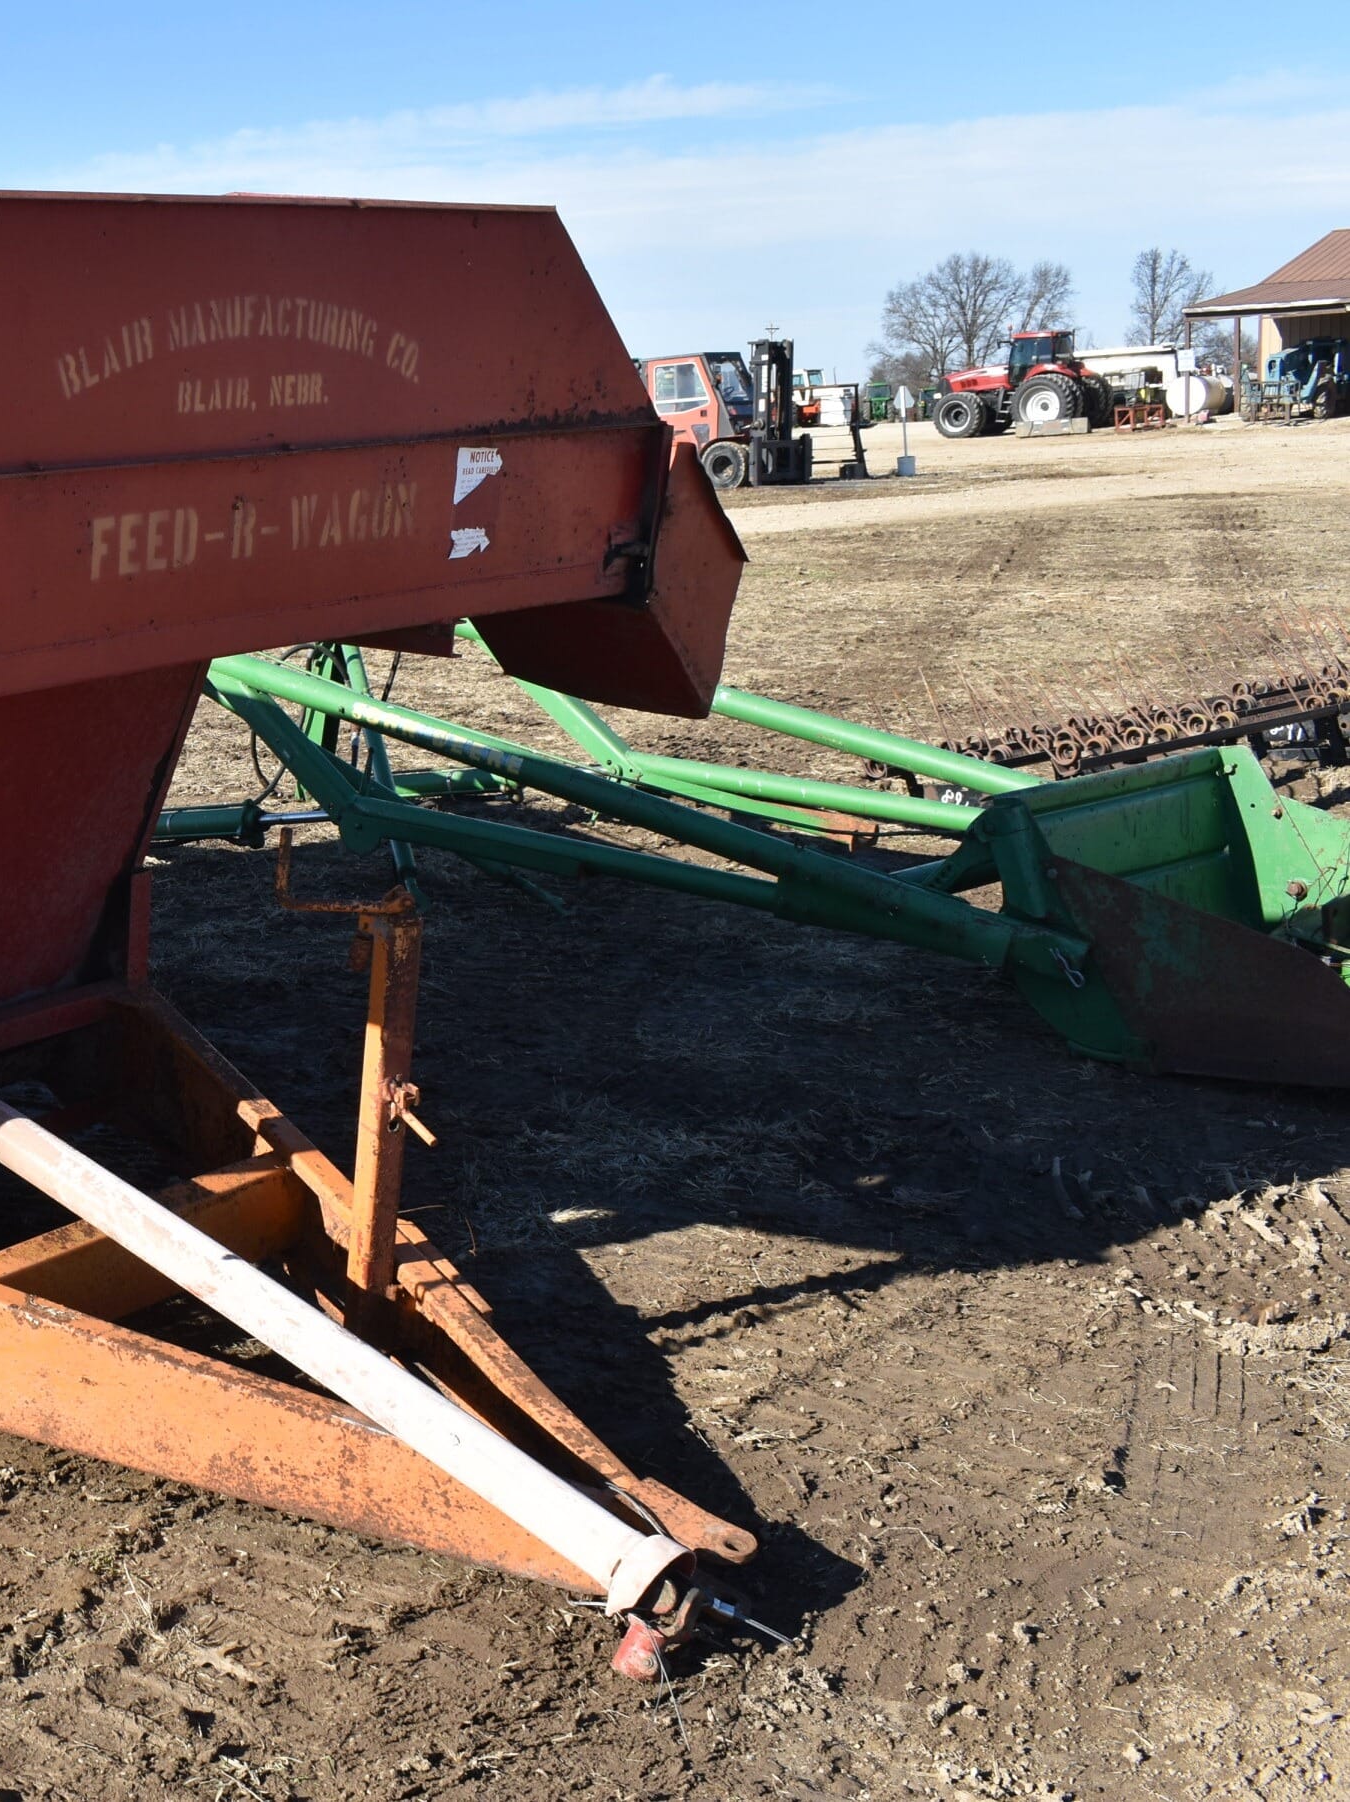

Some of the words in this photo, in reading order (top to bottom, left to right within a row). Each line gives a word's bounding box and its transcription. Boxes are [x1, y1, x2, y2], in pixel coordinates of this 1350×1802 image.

[57, 318, 154, 400] BLAIR
[167, 294, 378, 357] MANUFACTURING
[386, 331, 419, 384] CO.
[177, 376, 257, 413] BLAIR,
[269, 373, 329, 407] NEBR.
[470, 451, 495, 463] NOTICE
[462, 467, 475, 475] READ
